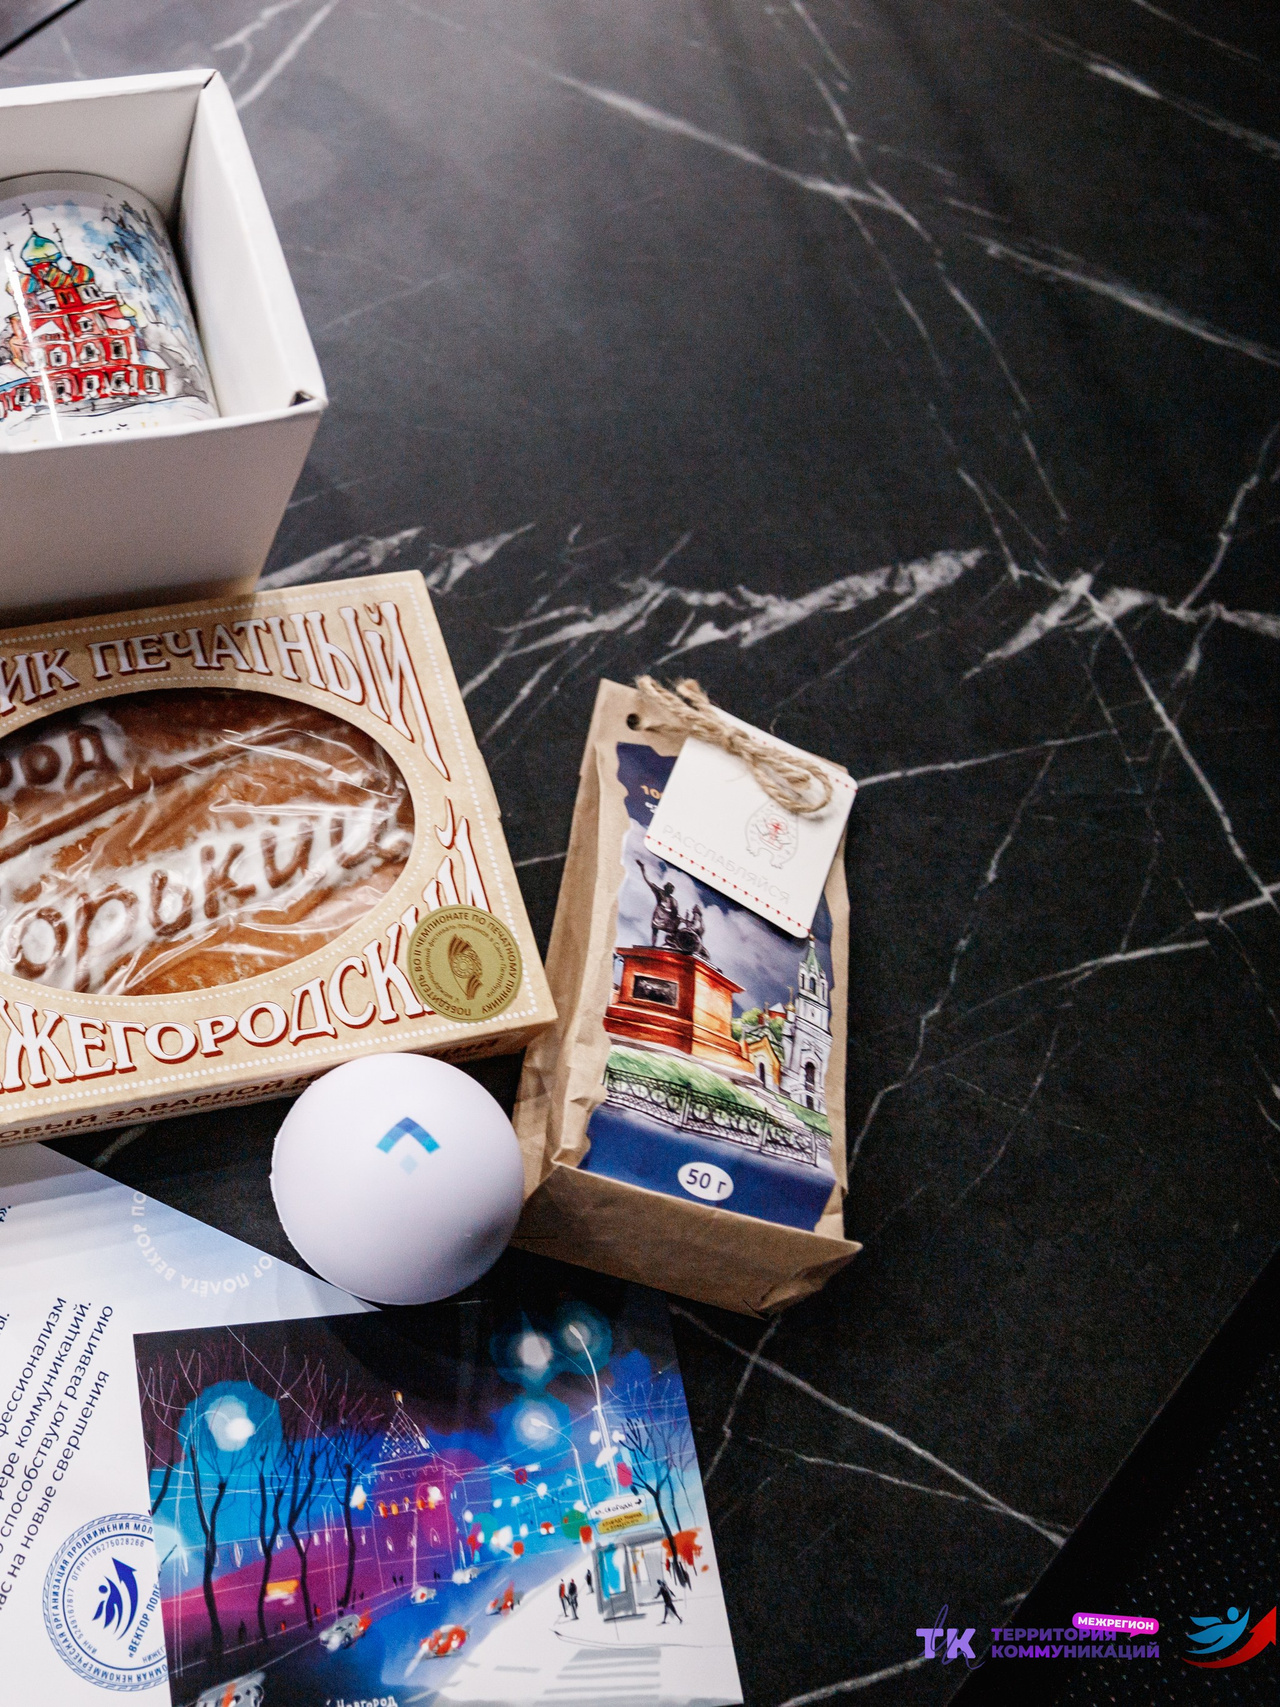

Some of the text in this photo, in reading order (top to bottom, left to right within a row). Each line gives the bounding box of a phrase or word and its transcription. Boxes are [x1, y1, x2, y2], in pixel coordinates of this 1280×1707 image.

[88, 602, 451, 781] ПЕЧАТНЫЙ
[663, 825, 790, 904] РАССЛАБЛЯЙСЯ
[415, 912, 469, 947] ЧЕМПИОНАТЕ
[472, 915, 485, 925] ПО
[488, 923, 517, 978] ПЕЧАТНОМУ
[418, 974, 471, 1015] ПОБЕДИТЕЛЬ
[106, 1078, 285, 1121] ЗАВАРНОЙ
[686, 1168, 711, 1189] 50
[133, 1224, 176, 1281] ВЕКТОР
[181, 1272, 250, 1297] ПОЛЁТА
[15, 1302, 91, 1448] коммуникаций.
[1, 1401, 68, 1537] способствуют
[64, 1306, 113, 1400] развитию
[8, 1554, 25, 1577] на
[21, 1486, 56, 1548] новые
[53, 1371, 109, 1481] свершения
[67, 1523, 130, 1558] ПРОДВИЖЕНИЯ
[72, 1561, 85, 1581] ОГРН
[51, 1560, 69, 1629] ОРГАНИЗАЦИЯ
[59, 1631, 133, 1683] НЕКОММЕРЧЕСКАЯ
[83, 1640, 97, 1655] ИНН
[128, 1613, 151, 1658] «ВЕКТОР
